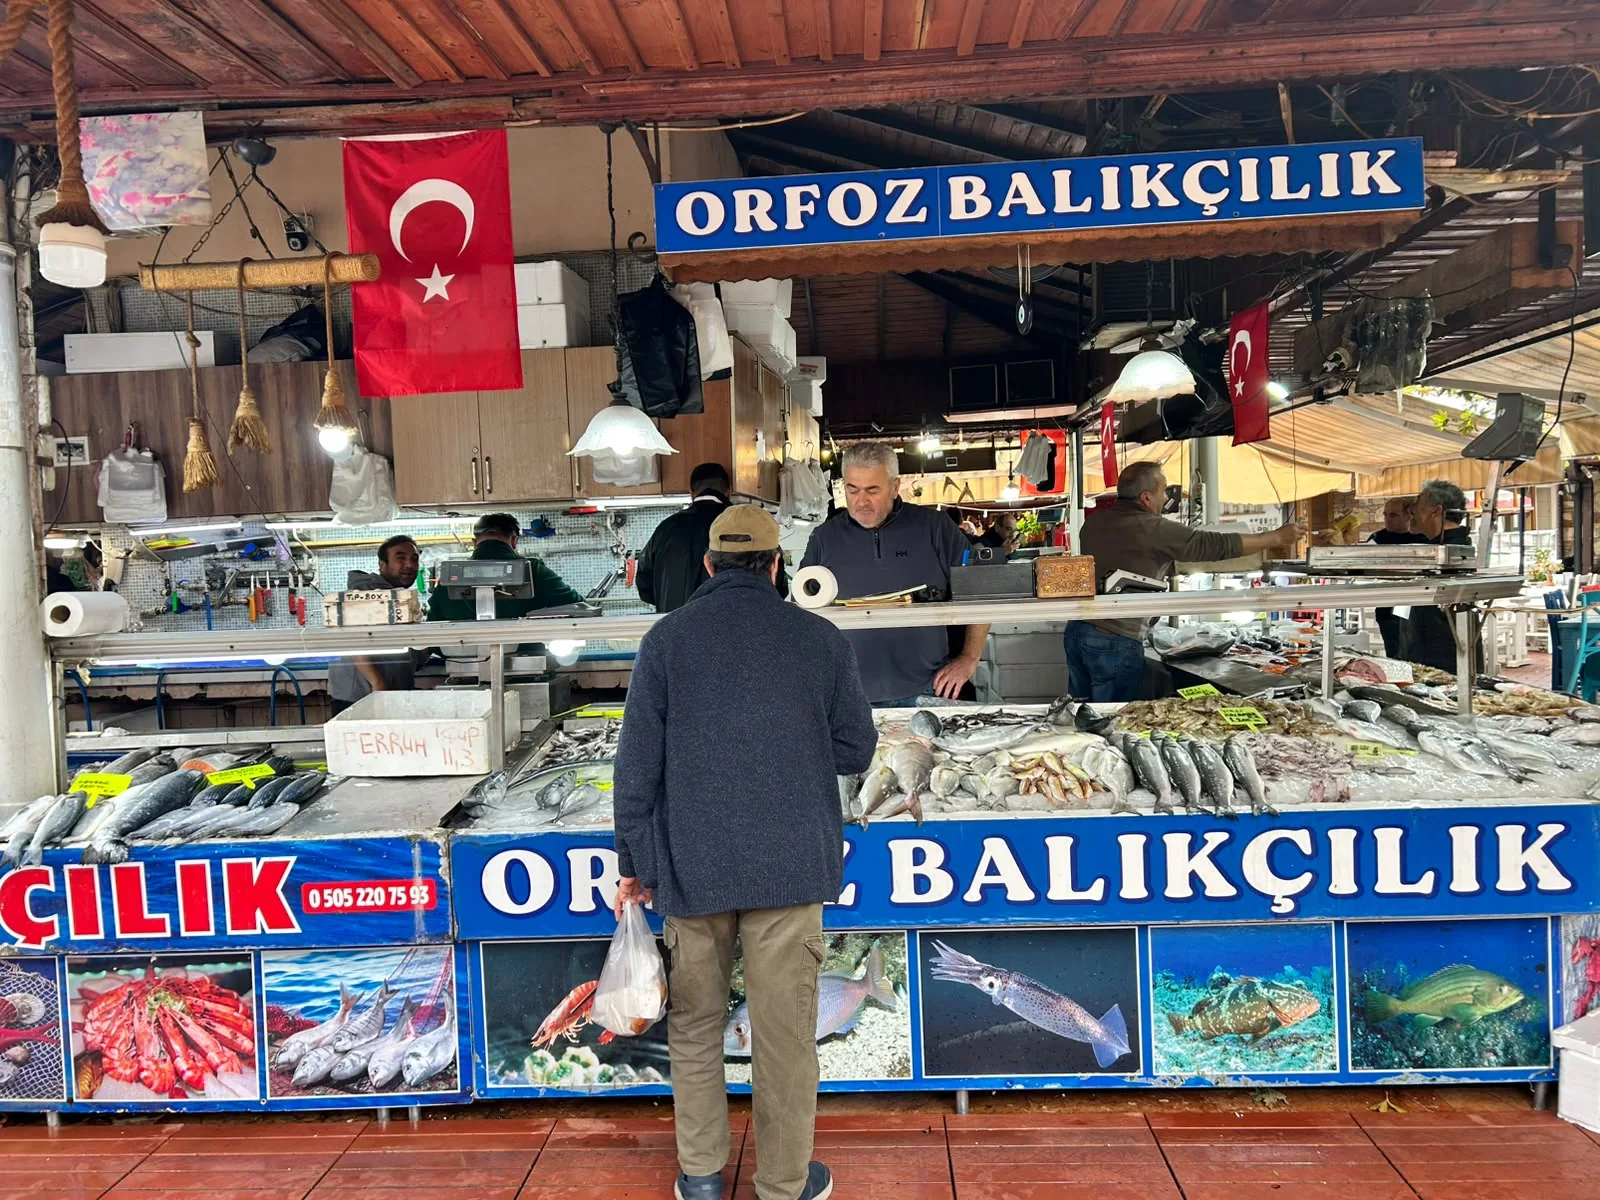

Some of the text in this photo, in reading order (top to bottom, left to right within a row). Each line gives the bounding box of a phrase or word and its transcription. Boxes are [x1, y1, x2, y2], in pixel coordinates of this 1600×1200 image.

[676, 149, 1401, 236] ORFOZ BALIKÇILIK
[0, 855, 302, 950] ÇILIK
[308, 885, 429, 908] 0 505 220 75 93
[888, 823, 1572, 914] BALIKÇILIK
